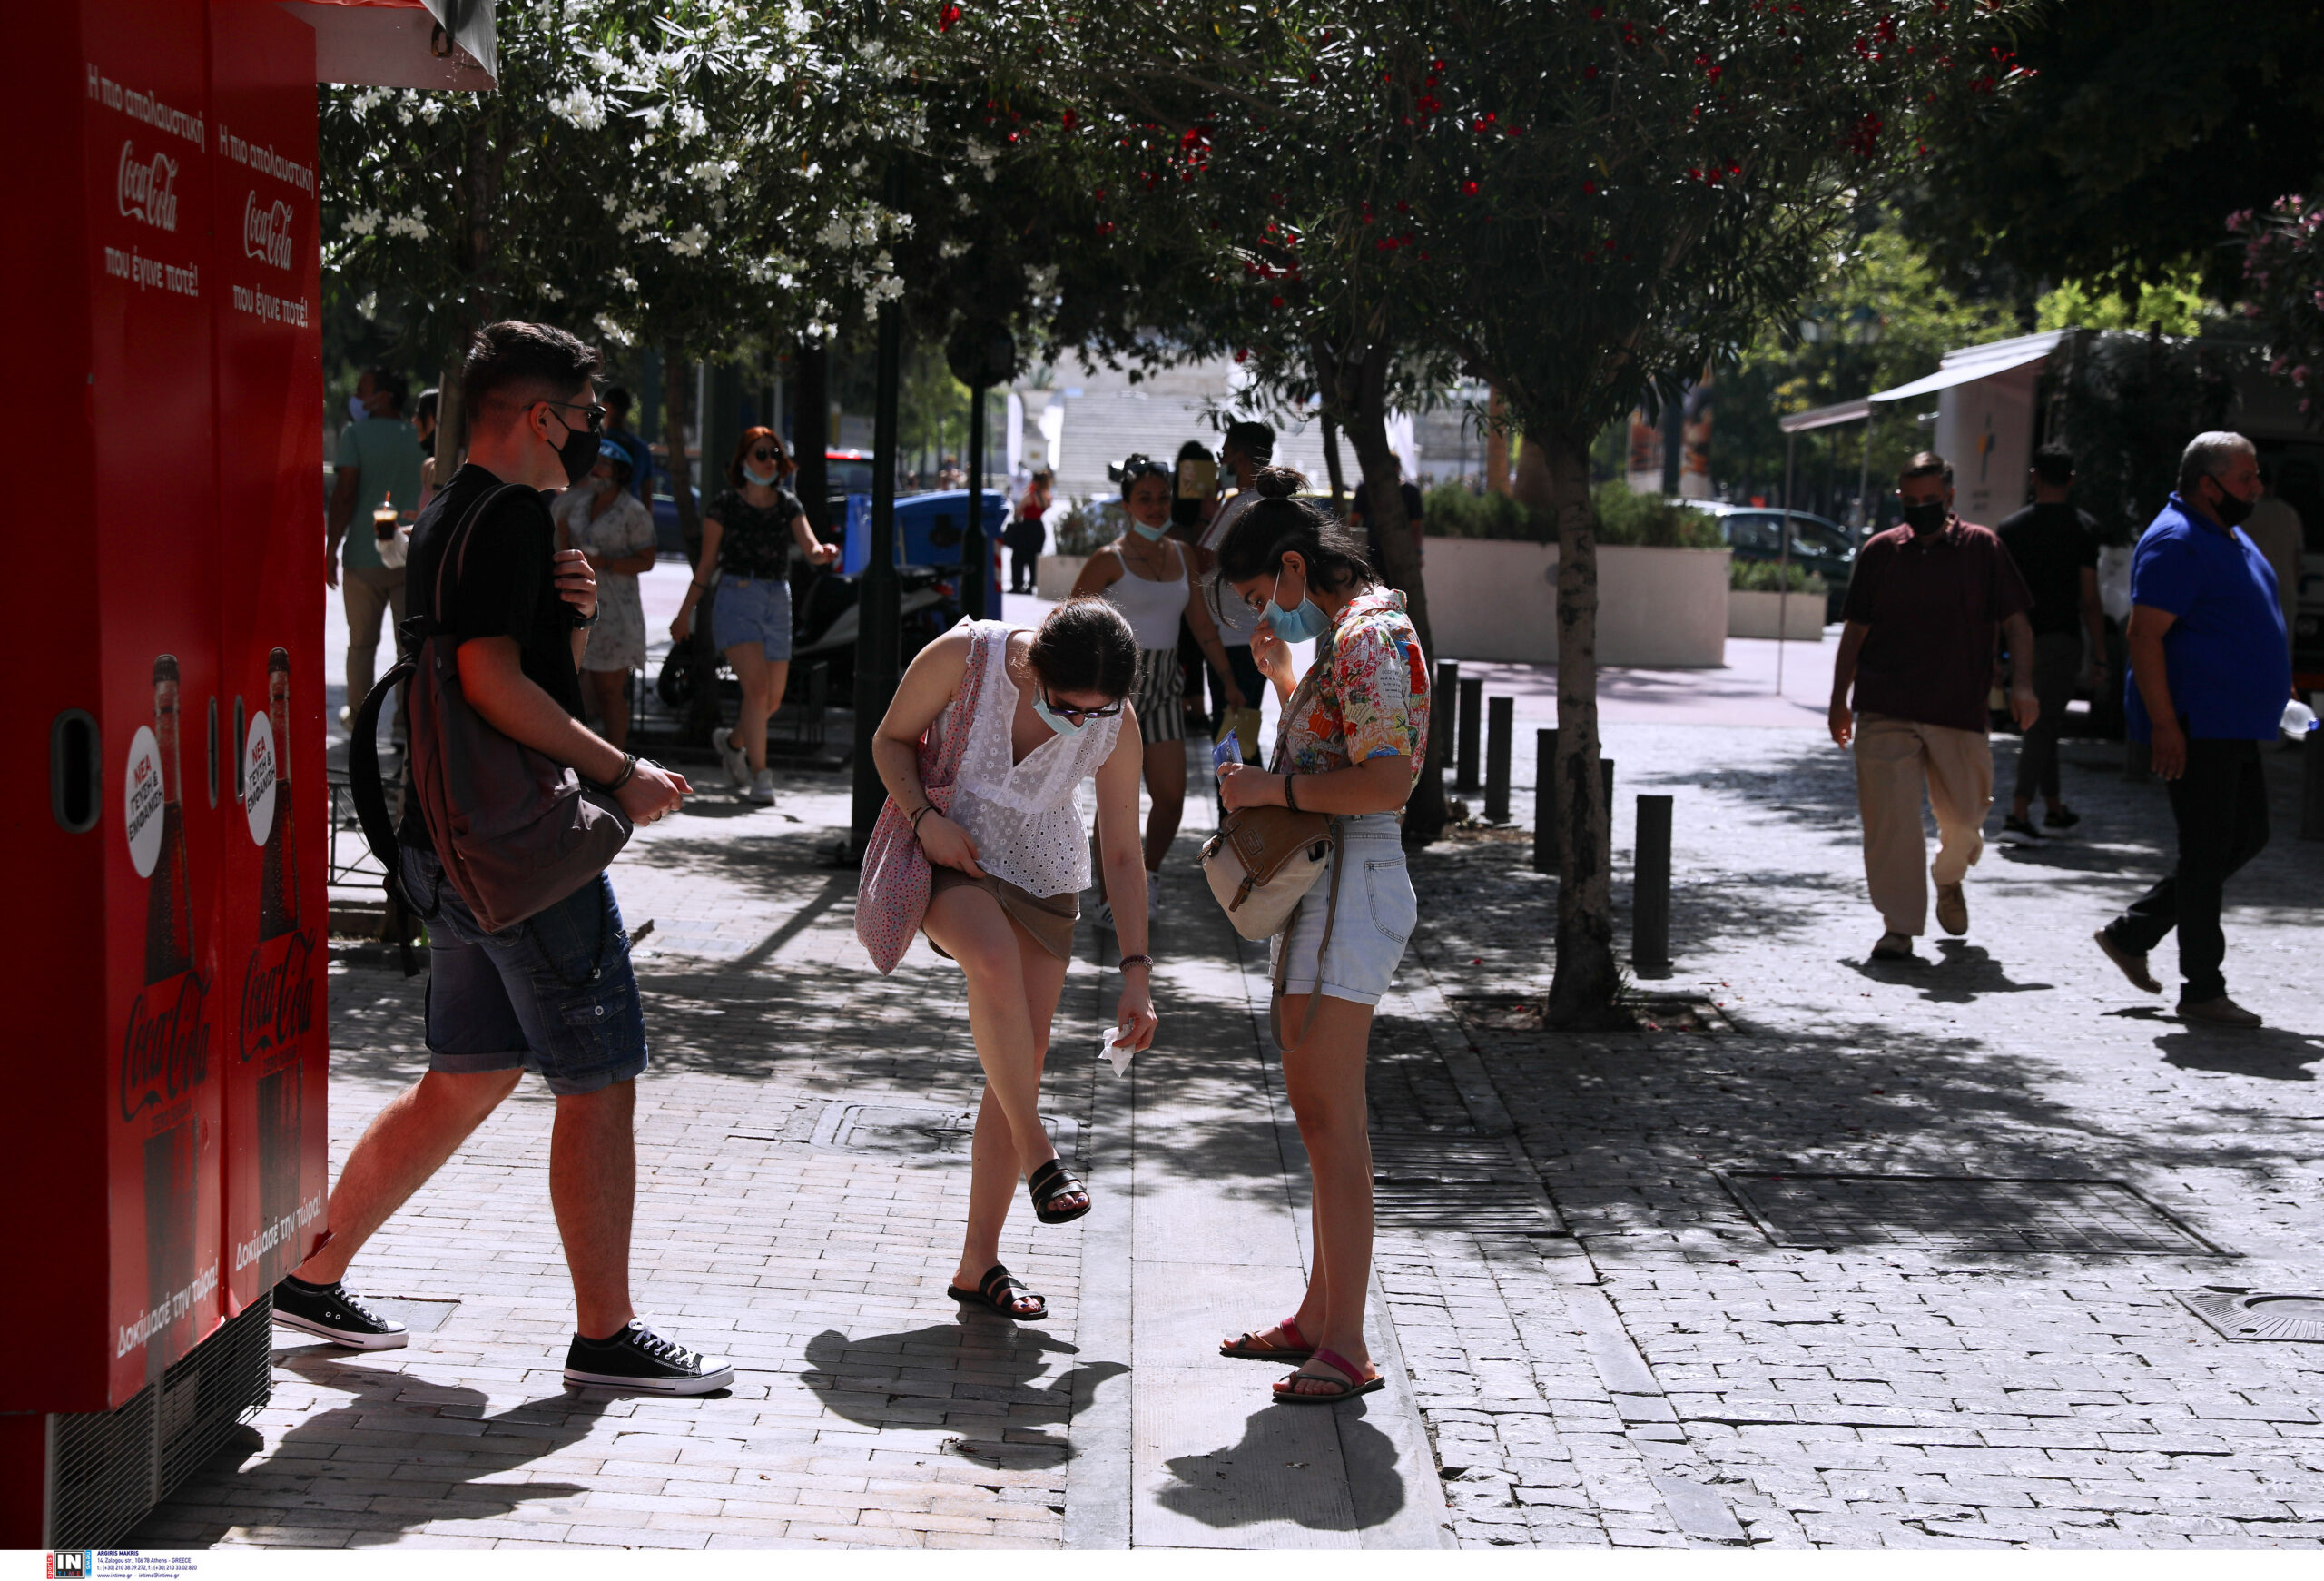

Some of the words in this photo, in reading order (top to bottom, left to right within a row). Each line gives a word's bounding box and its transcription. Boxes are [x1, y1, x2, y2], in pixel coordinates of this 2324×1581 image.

[101, 76, 123, 112] πιο
[125, 89, 205, 153] απολαυστική
[118, 139, 179, 232] Coca-Cola
[230, 134, 248, 165] πιο
[250, 144, 315, 199] απολαυστική
[243, 189, 293, 272] Coca-Cola
[104, 246, 130, 280] που
[133, 245, 164, 291] έγινε
[165, 262, 199, 297] ποτέ!
[232, 284, 254, 313] που
[256, 283, 281, 324] έγινε
[282, 297, 309, 328] ποτέ!
[153, 770, 159, 787] &
[267, 751, 272, 766] &
[240, 926, 316, 1063] Coca-Cola
[121, 966, 212, 1123] Coca-Cola
[235, 1216, 279, 1271] Δοκίμασέ
[280, 1211, 295, 1242] την
[296, 1189, 321, 1228] τώρα!
[117, 1291, 170, 1359] Δοκίμασέ
[172, 1287, 191, 1319] την
[192, 1257, 218, 1301] τώρα!
